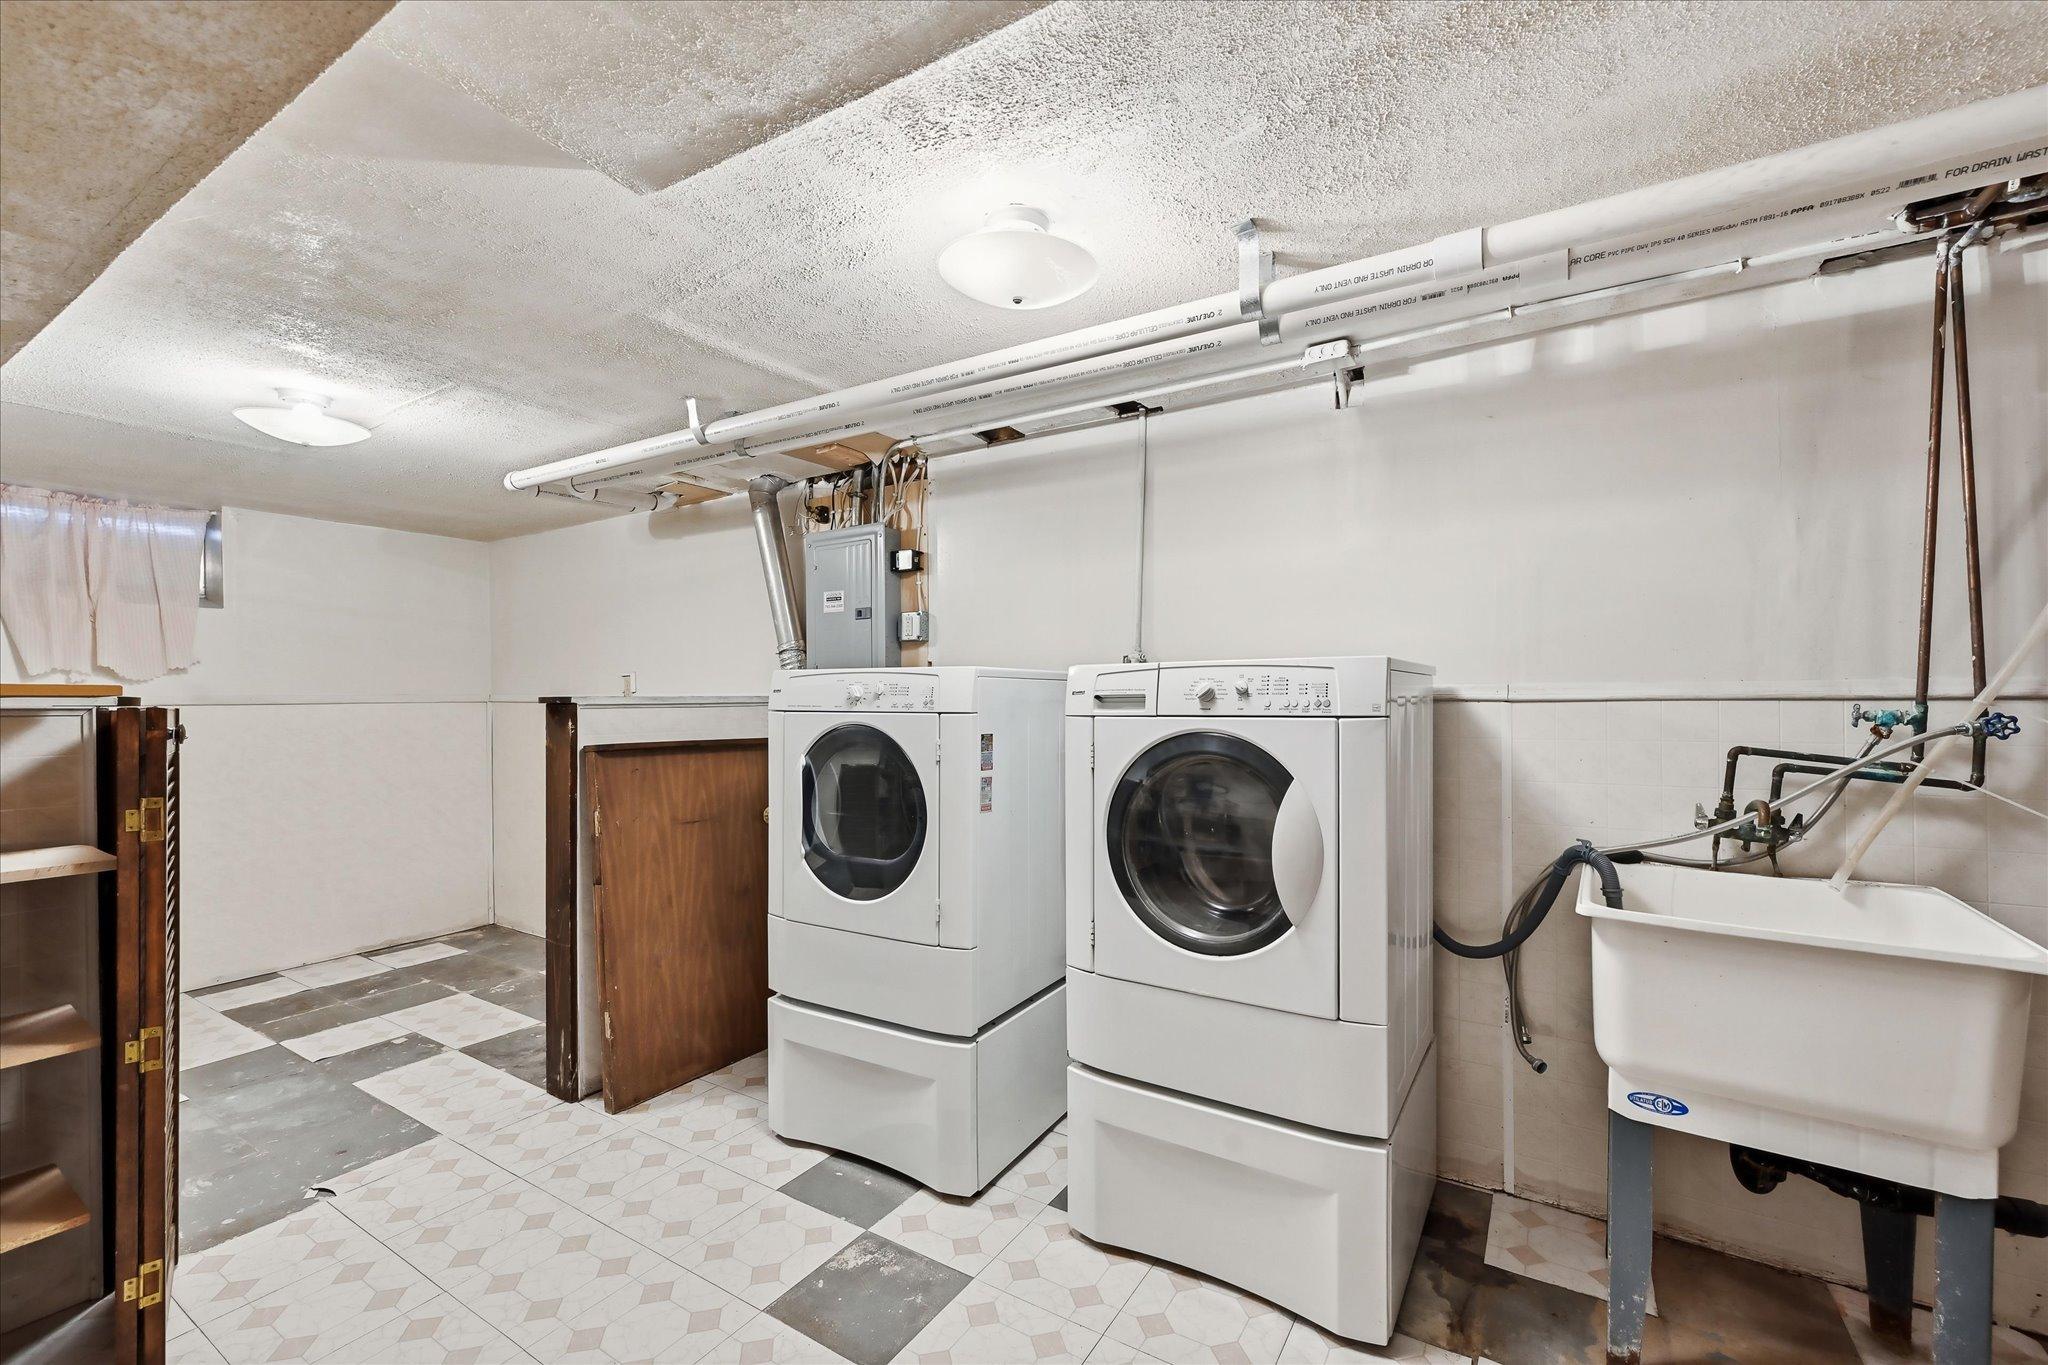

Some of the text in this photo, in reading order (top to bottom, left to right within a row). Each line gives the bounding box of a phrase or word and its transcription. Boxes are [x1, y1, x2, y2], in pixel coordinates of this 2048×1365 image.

[1583, 251, 1606, 263] CORE
[1621, 246, 1635, 254] PIPE
[1687, 228, 1710, 239] SERIES
[1740, 218, 1758, 226] ASTM
[1759, 210, 1789, 222] F891-16
[1945, 166, 1969, 179] FOR
[2016, 146, 2048, 162] WAST
[1354, 274, 1368, 284] AND
[1370, 268, 1394, 280] WASTE
[1314, 283, 1332, 293] ONLY
[1334, 278, 1352, 289] VENT
[1402, 296, 1417, 305] FOR
[1340, 311, 1354, 319] AND
[1355, 305, 1377, 316] WASTE
[1305, 318, 1321, 327] ONLY
[1322, 314, 1340, 324] VENT
